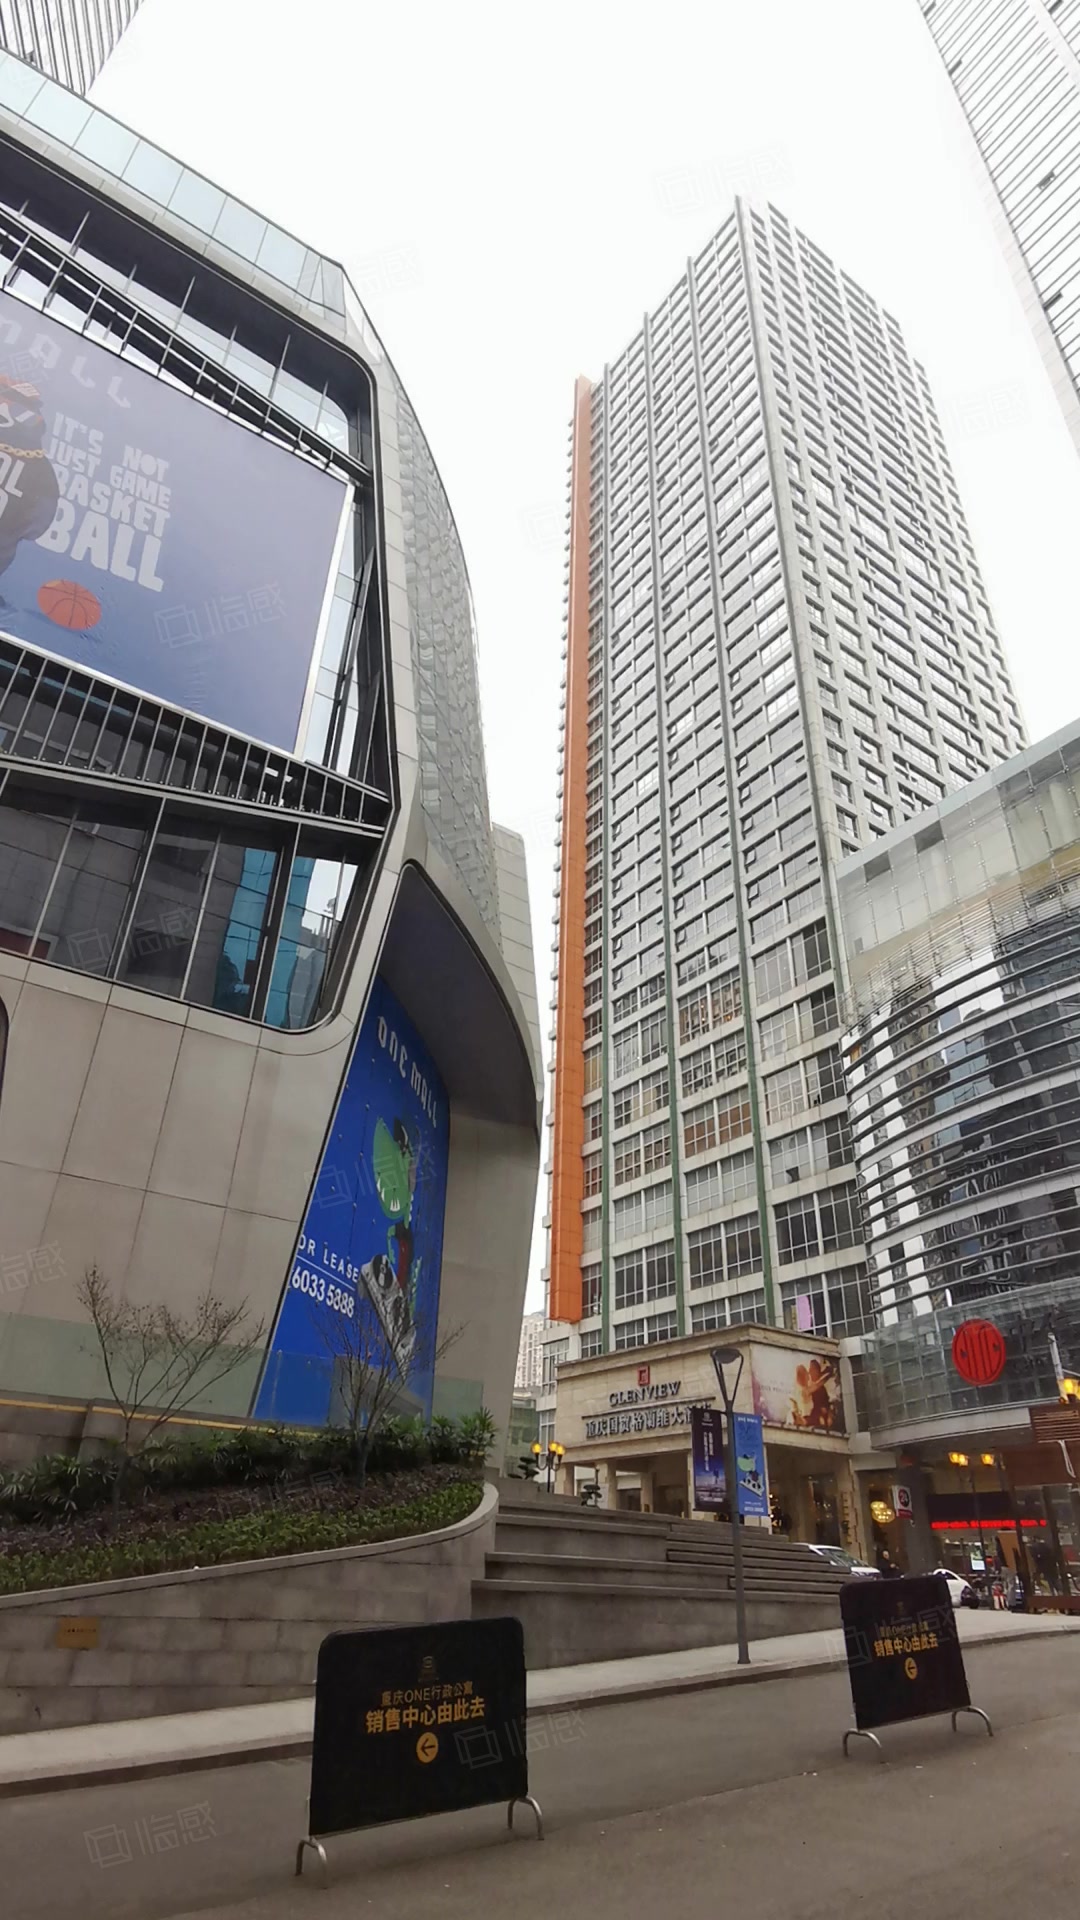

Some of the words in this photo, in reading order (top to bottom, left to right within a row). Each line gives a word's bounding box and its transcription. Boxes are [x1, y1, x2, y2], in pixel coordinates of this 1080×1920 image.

[52, 412, 104, 455] IT'S
[122, 445, 169, 482] NOT
[110, 465, 172, 509] GAME
[35, 497, 164, 592] BALL
[323, 1248, 359, 1283] LEASE
[609, 1380, 682, 1407] GLENVIEW
[365, 1695, 486, 1735] 销售中心由此去
